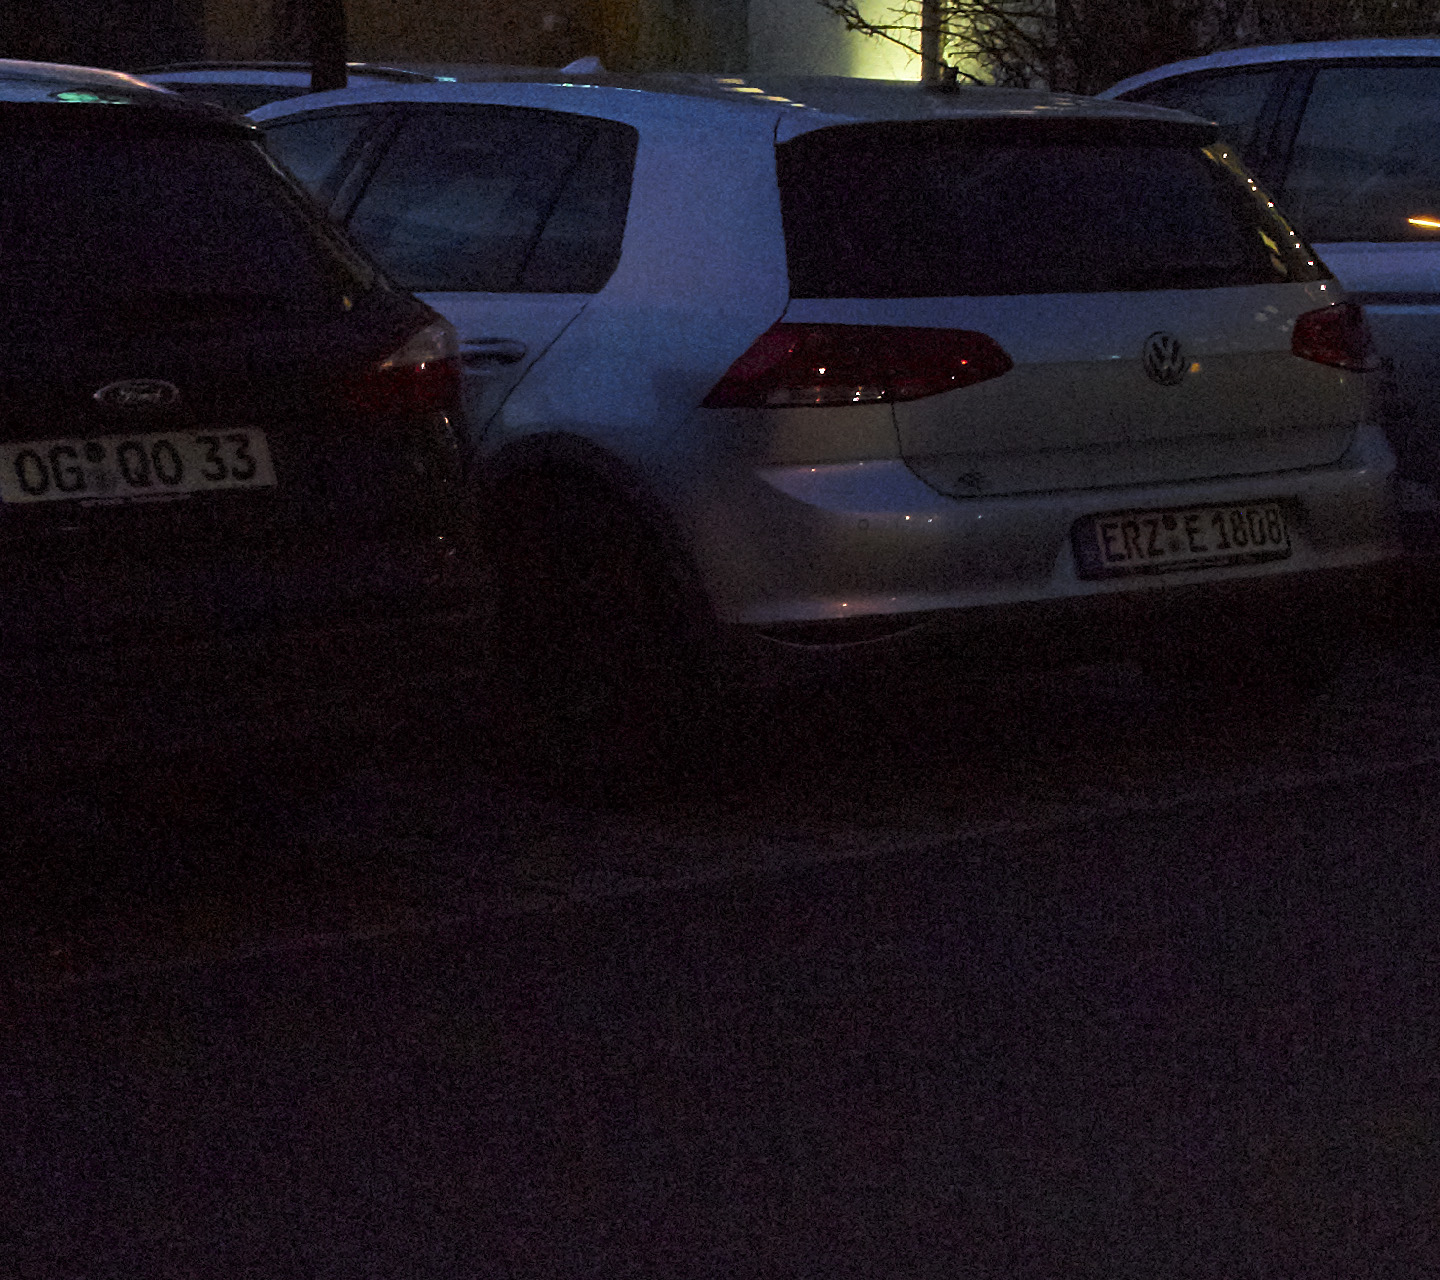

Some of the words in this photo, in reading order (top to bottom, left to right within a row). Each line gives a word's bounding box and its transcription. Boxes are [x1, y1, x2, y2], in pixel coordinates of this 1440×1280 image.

[197, 435, 256, 480] 33
[1101, 519, 1163, 562] ERZ
[1184, 515, 1207, 552] E
